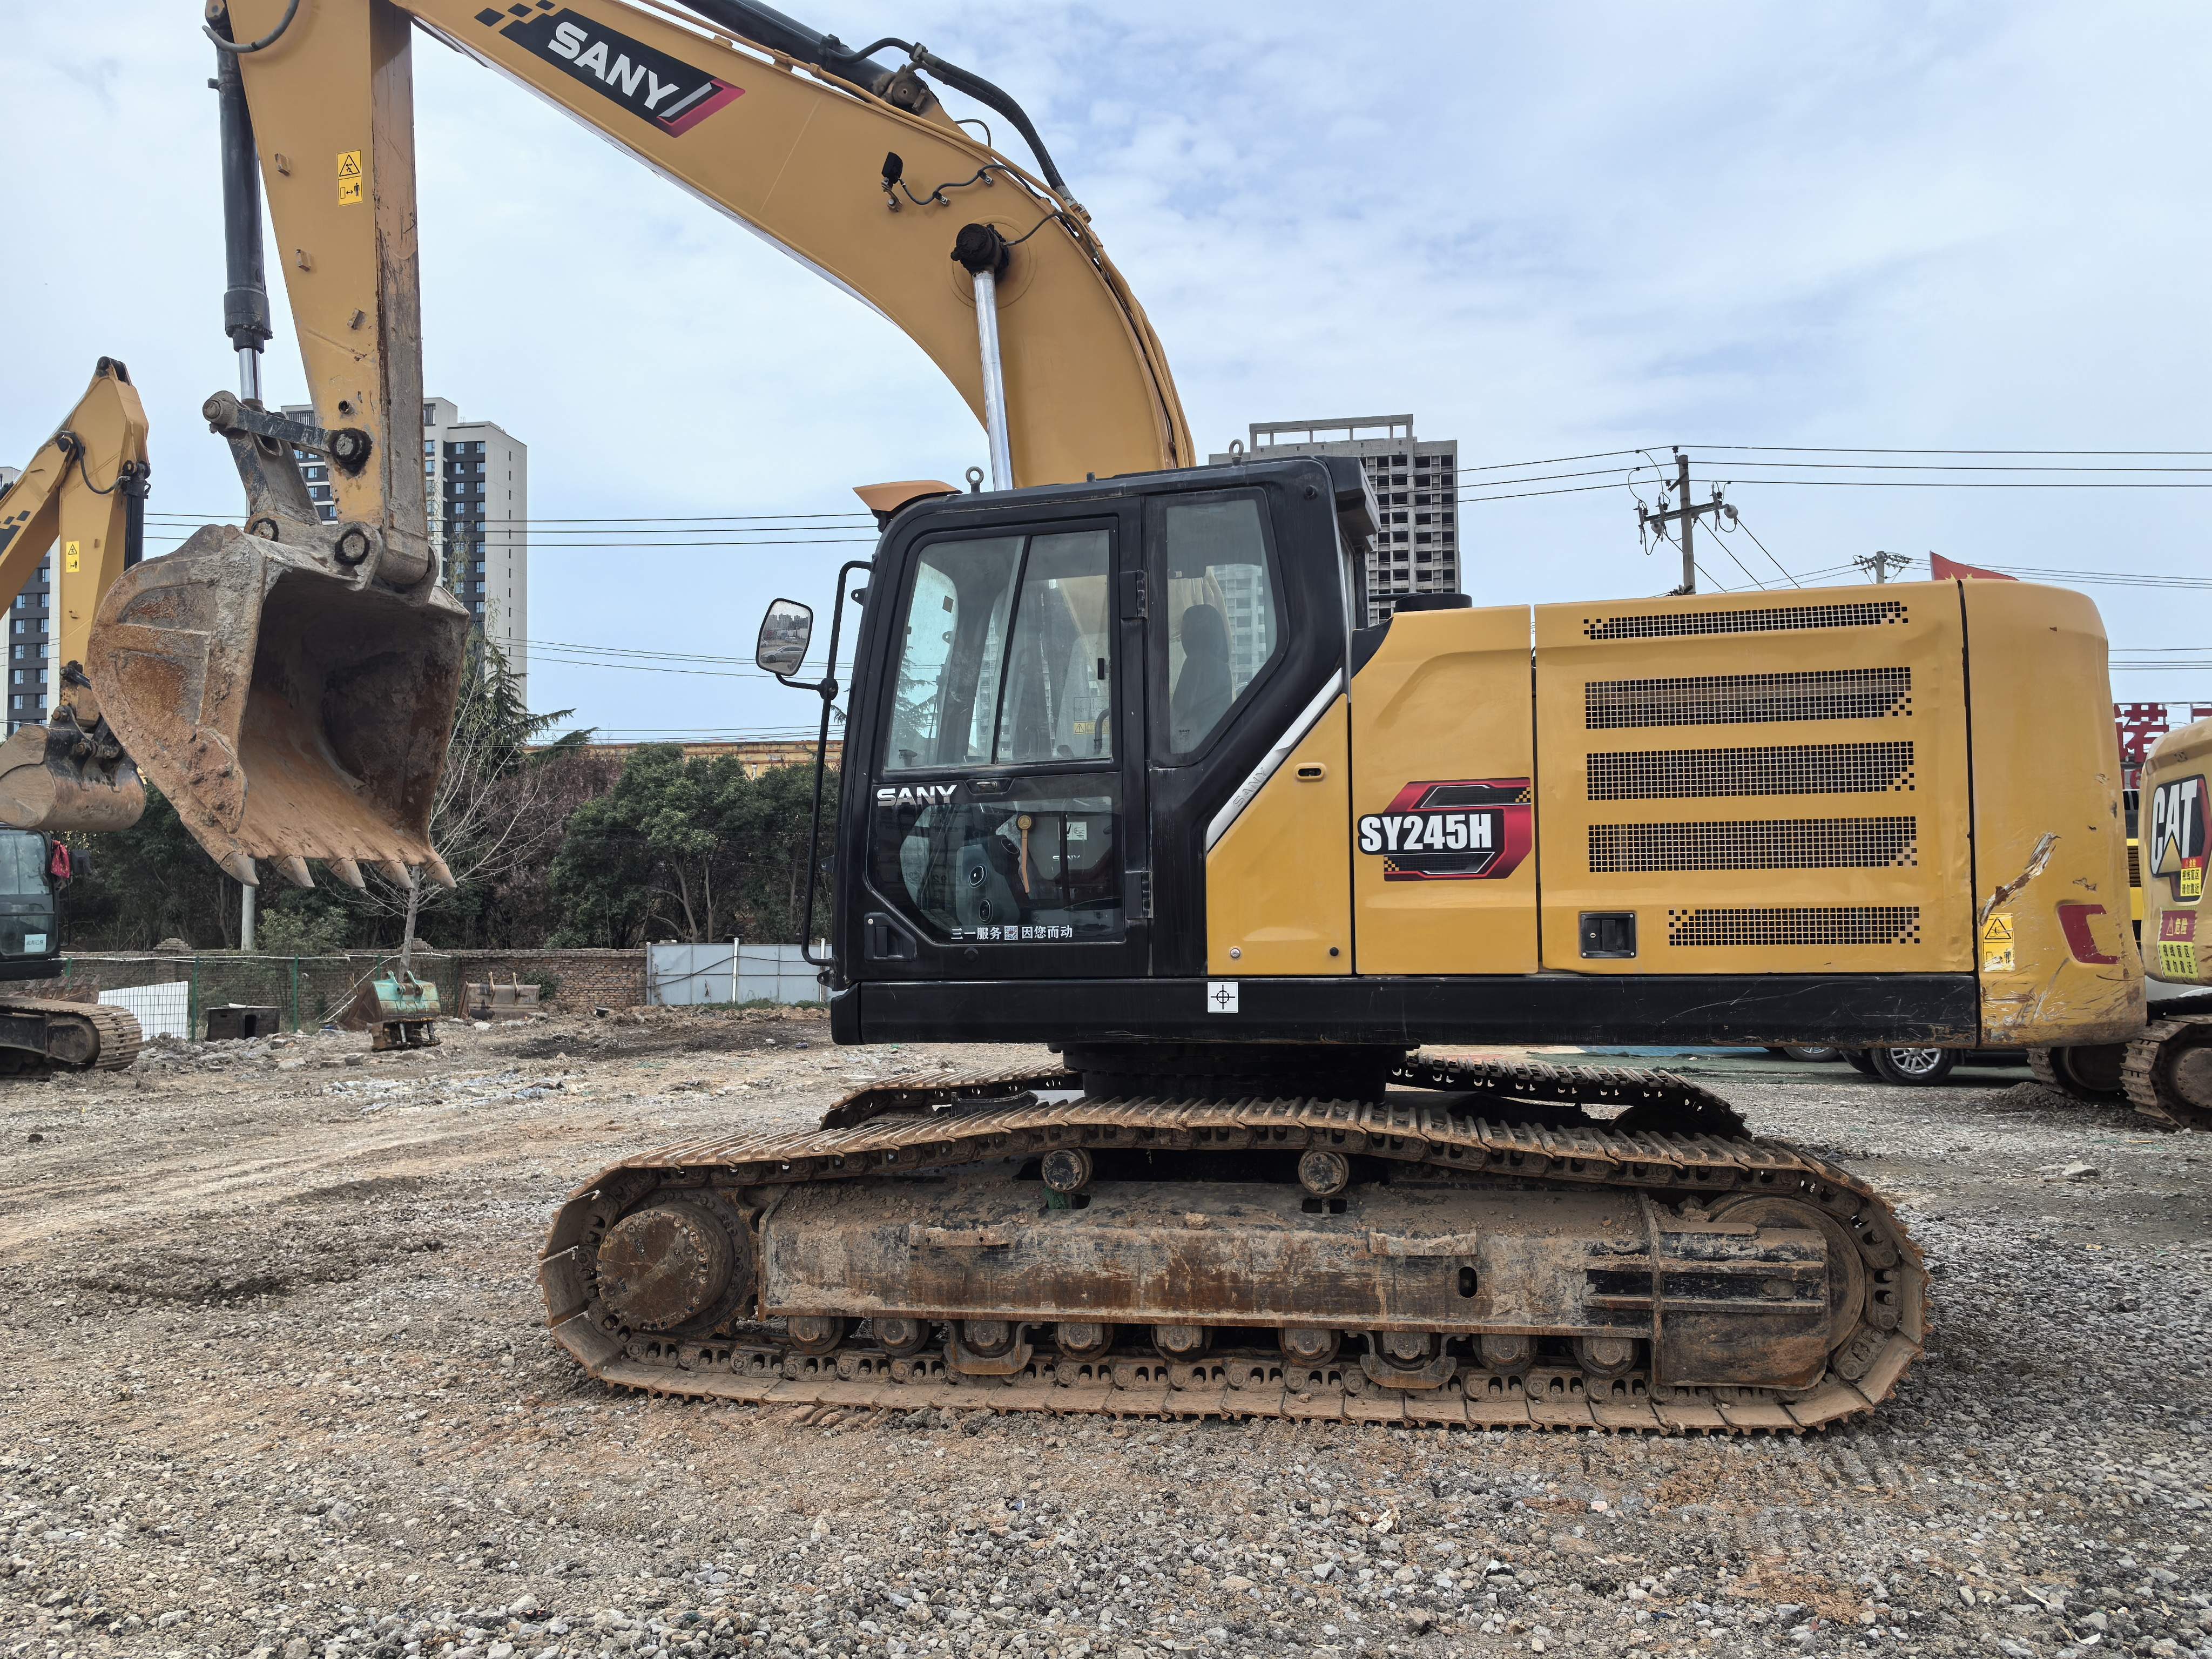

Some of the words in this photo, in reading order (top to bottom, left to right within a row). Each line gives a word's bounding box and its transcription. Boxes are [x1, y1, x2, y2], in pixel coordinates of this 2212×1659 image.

[548, 22, 680, 110] SANY
[877, 784, 957, 807] SANY
[1232, 767, 1266, 808] SANY
[1360, 813, 1492, 852] SY245H
[2151, 779, 2197, 874] CAT
[951, 927, 1002, 940] 三一服务
[1021, 925, 1073, 939] 因您而动
[2174, 918, 2188, 935] 危险
